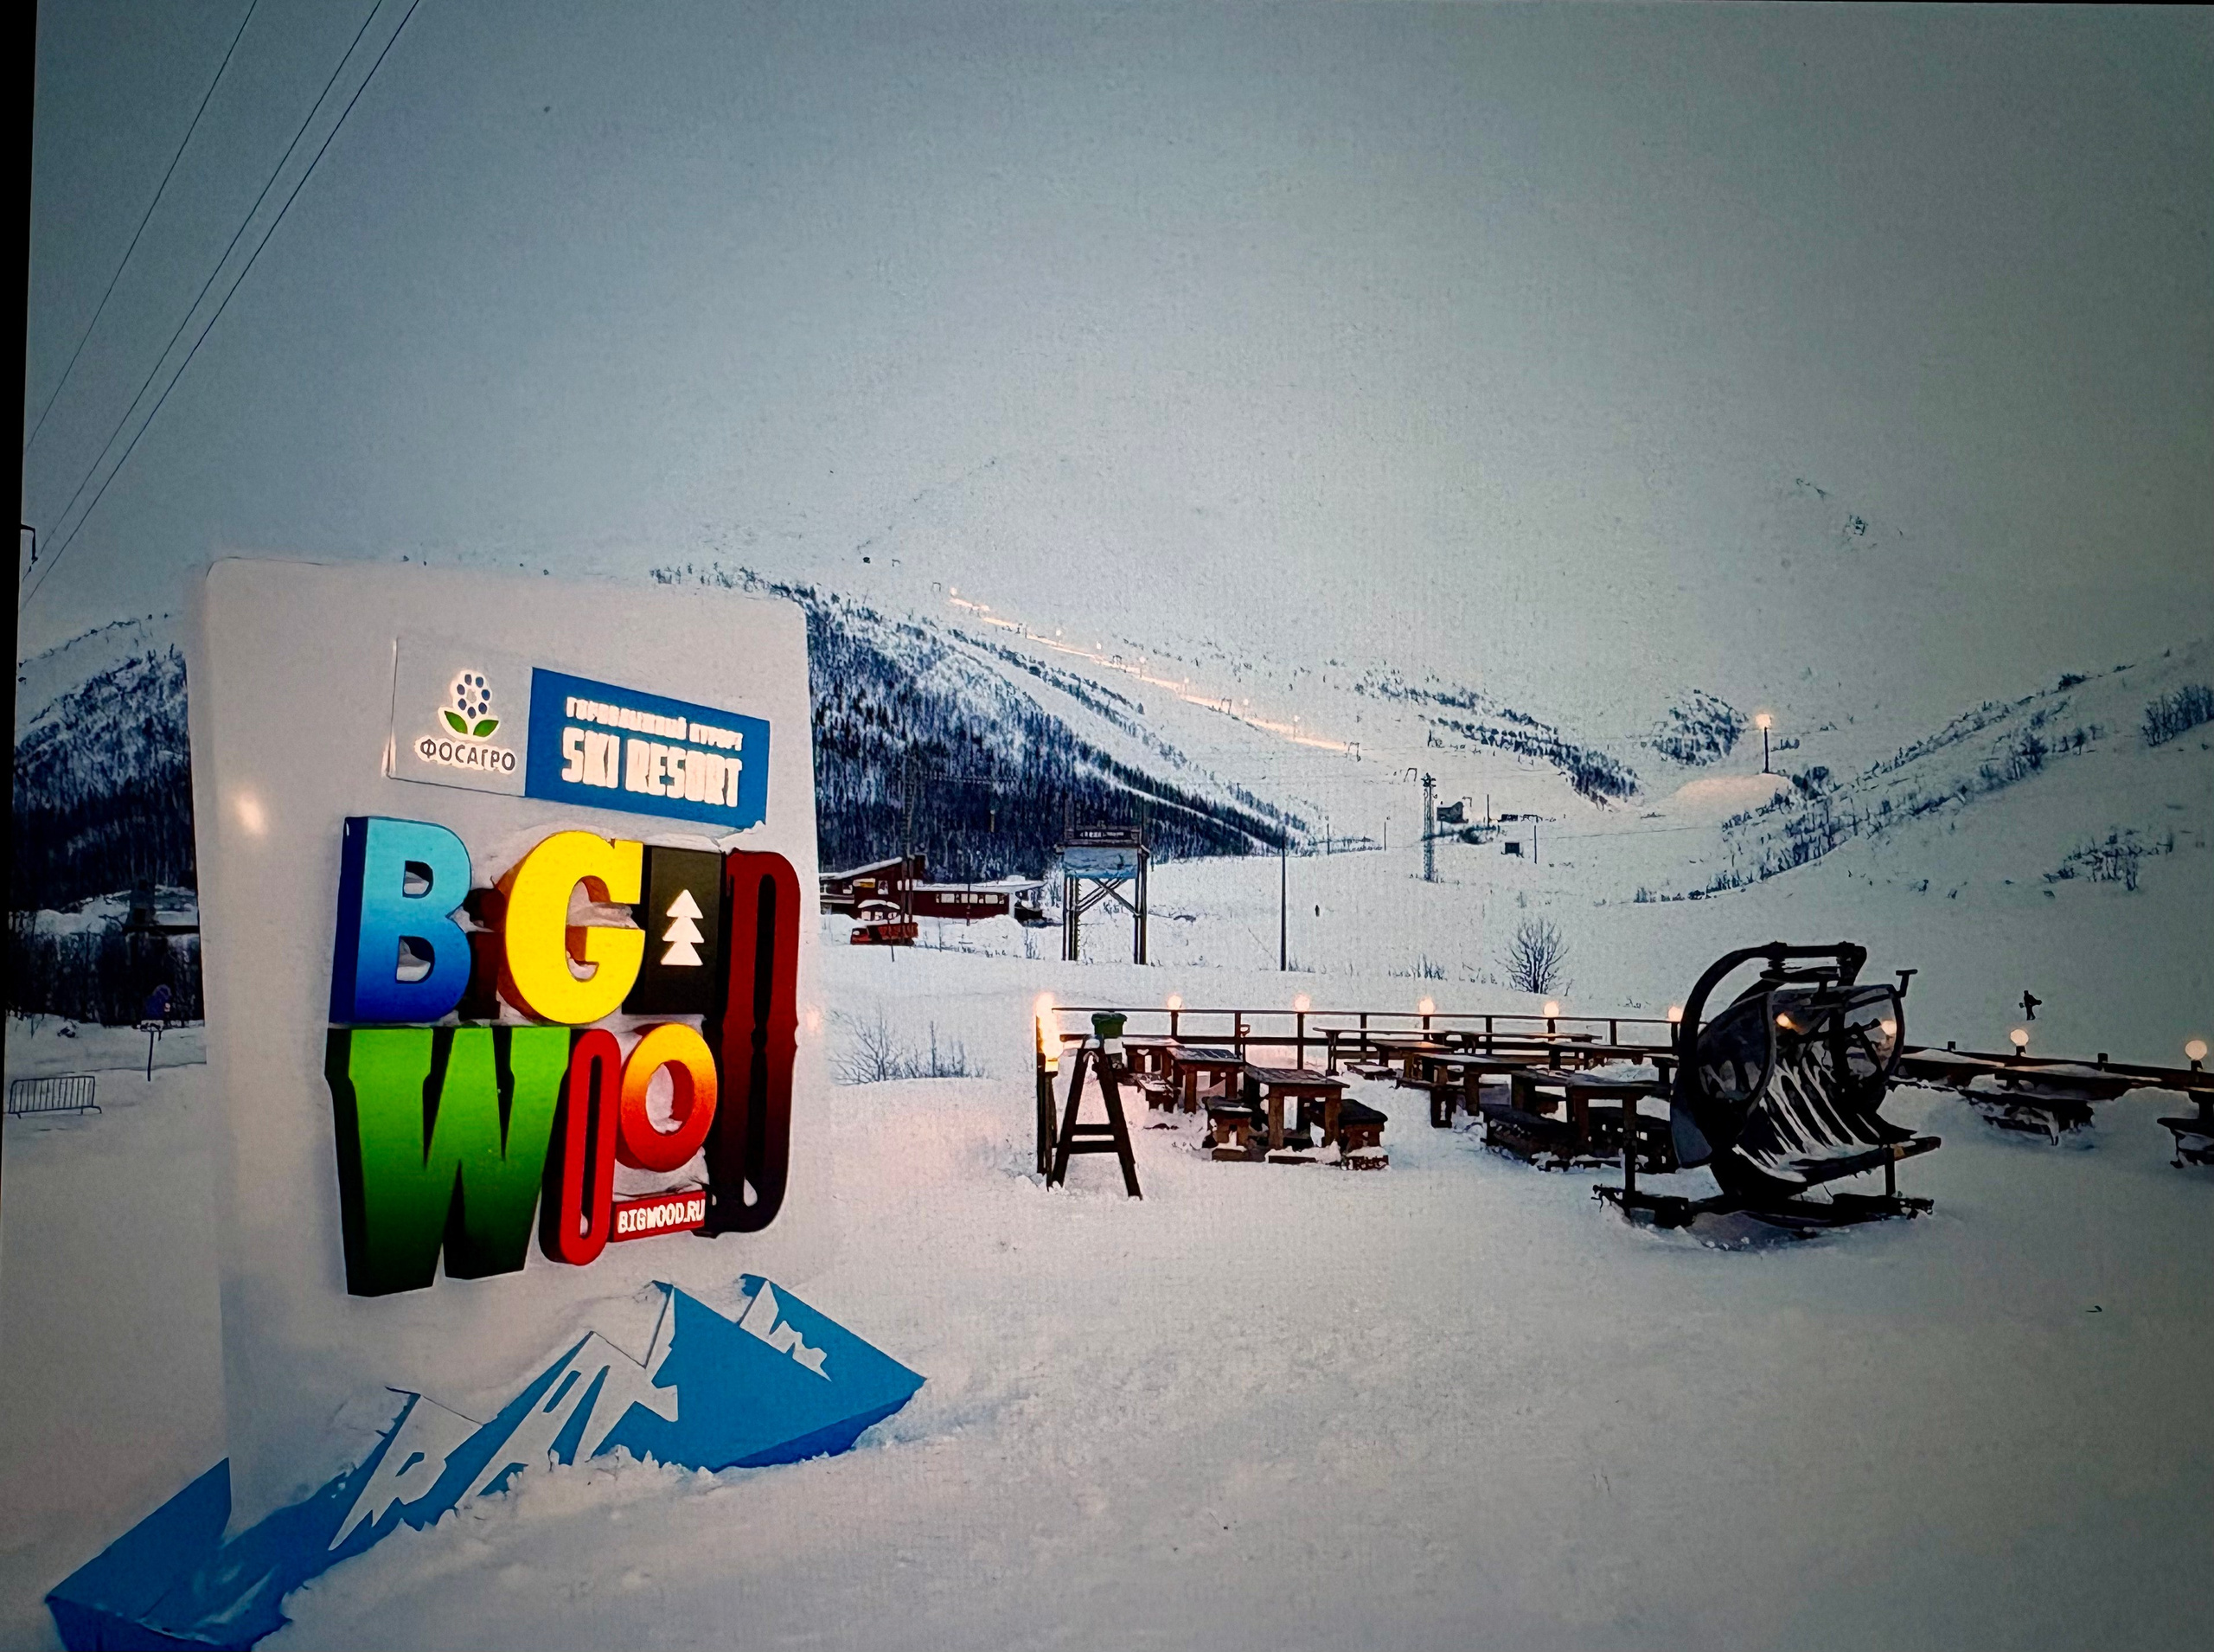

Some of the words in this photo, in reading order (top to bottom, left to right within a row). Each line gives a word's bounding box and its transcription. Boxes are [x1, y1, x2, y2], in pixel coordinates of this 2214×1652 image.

[419, 738, 516, 772] ФОСАГРО
[562, 727, 621, 789] SKI
[625, 739, 743, 807] RESORT
[617, 1199, 706, 1234] BIGWOOD.RU
